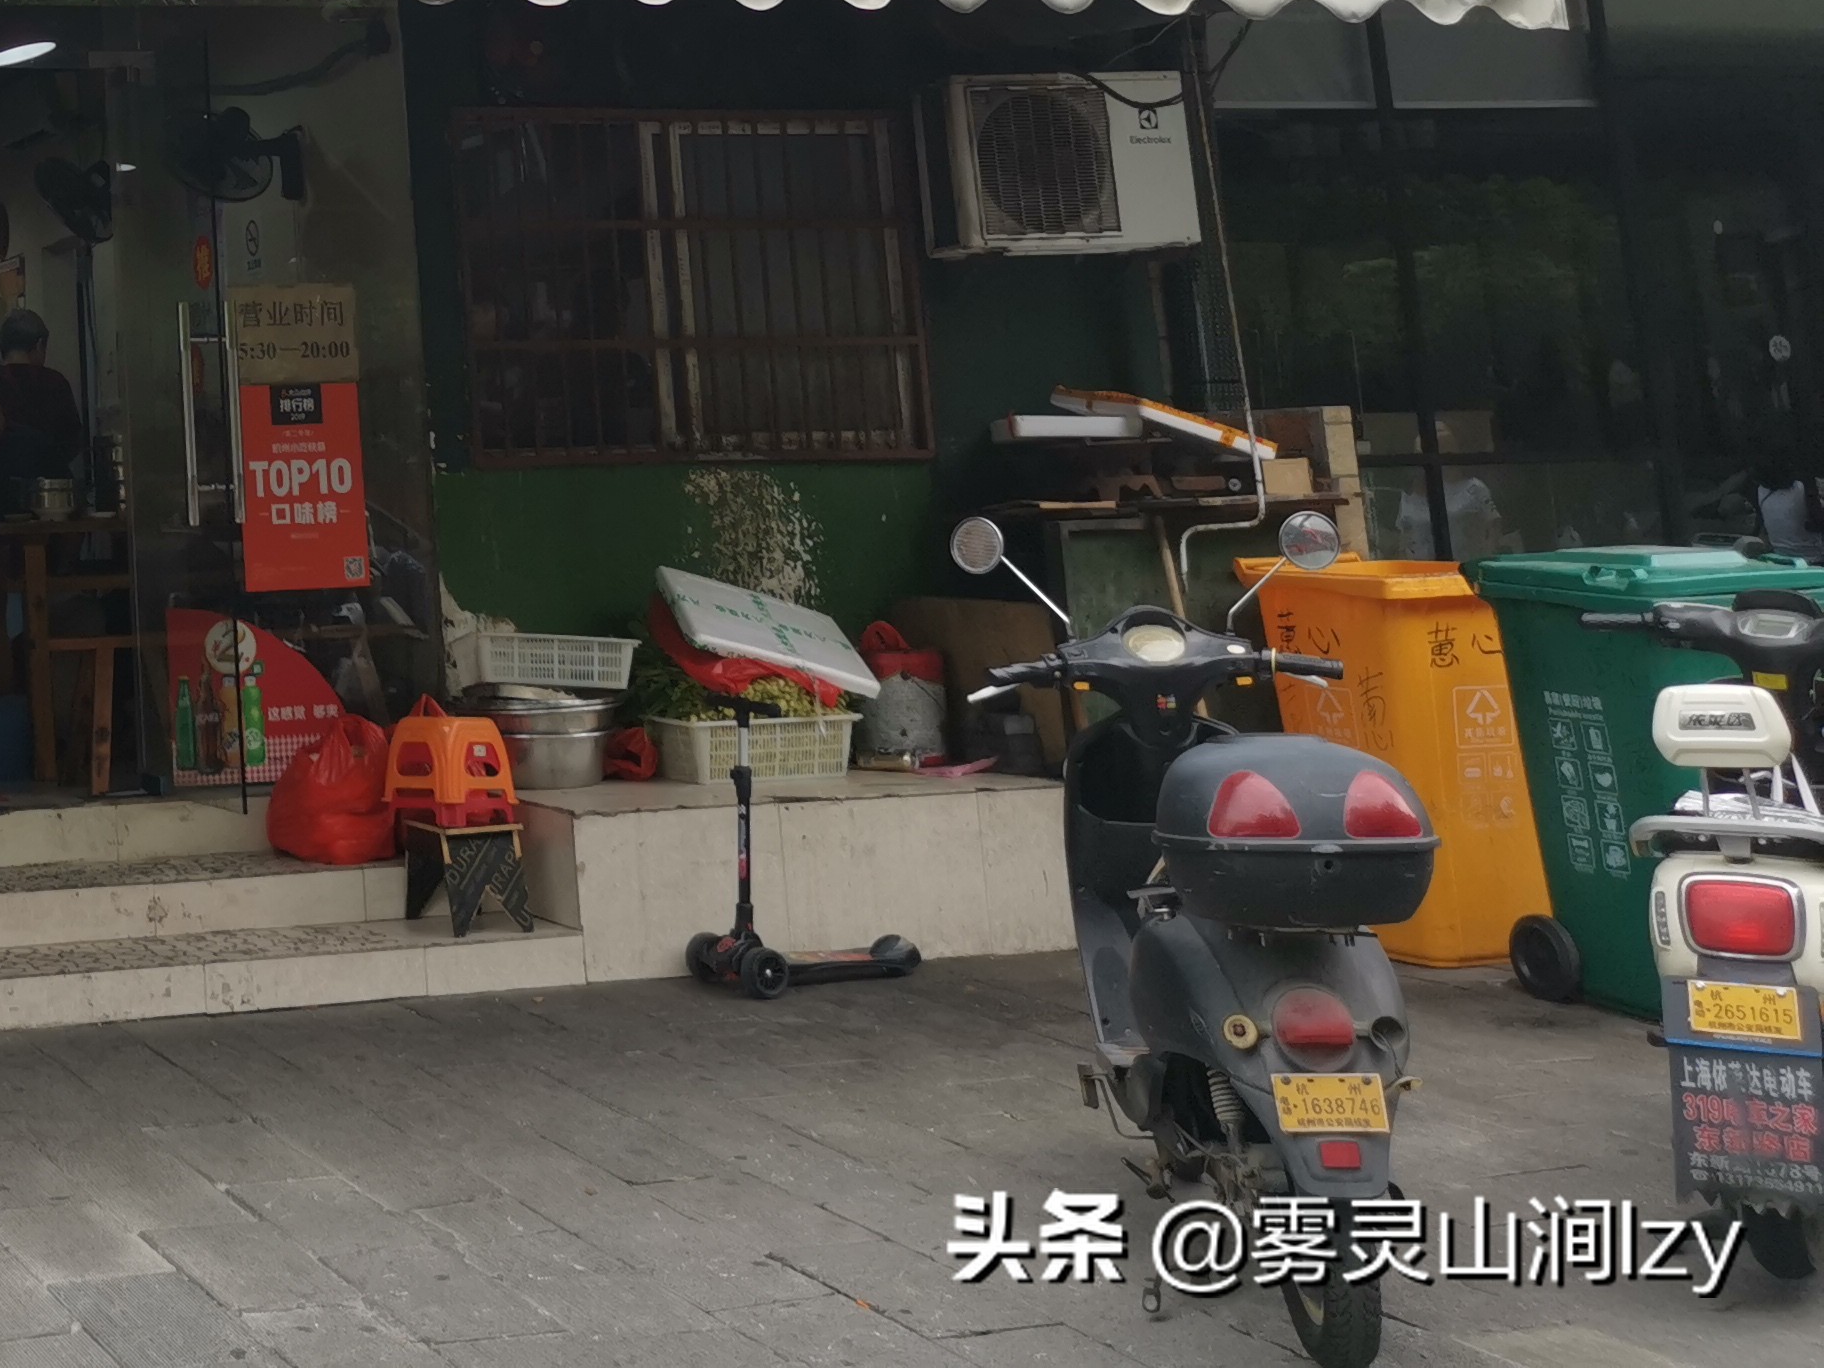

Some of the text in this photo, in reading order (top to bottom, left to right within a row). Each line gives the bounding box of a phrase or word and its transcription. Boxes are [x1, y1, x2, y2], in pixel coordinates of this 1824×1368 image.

[1129, 135, 1172, 144] Electrolux
[238, 299, 345, 329] 营业时间
[249, 457, 353, 498] TOP10
[270, 500, 338, 525] 口味榜
[1709, 989, 1777, 1006] 杭州
[1713, 1003, 1794, 1026] 2651615
[1296, 1083, 1363, 1096] 杭州
[1301, 1097, 1381, 1116] 1638746
